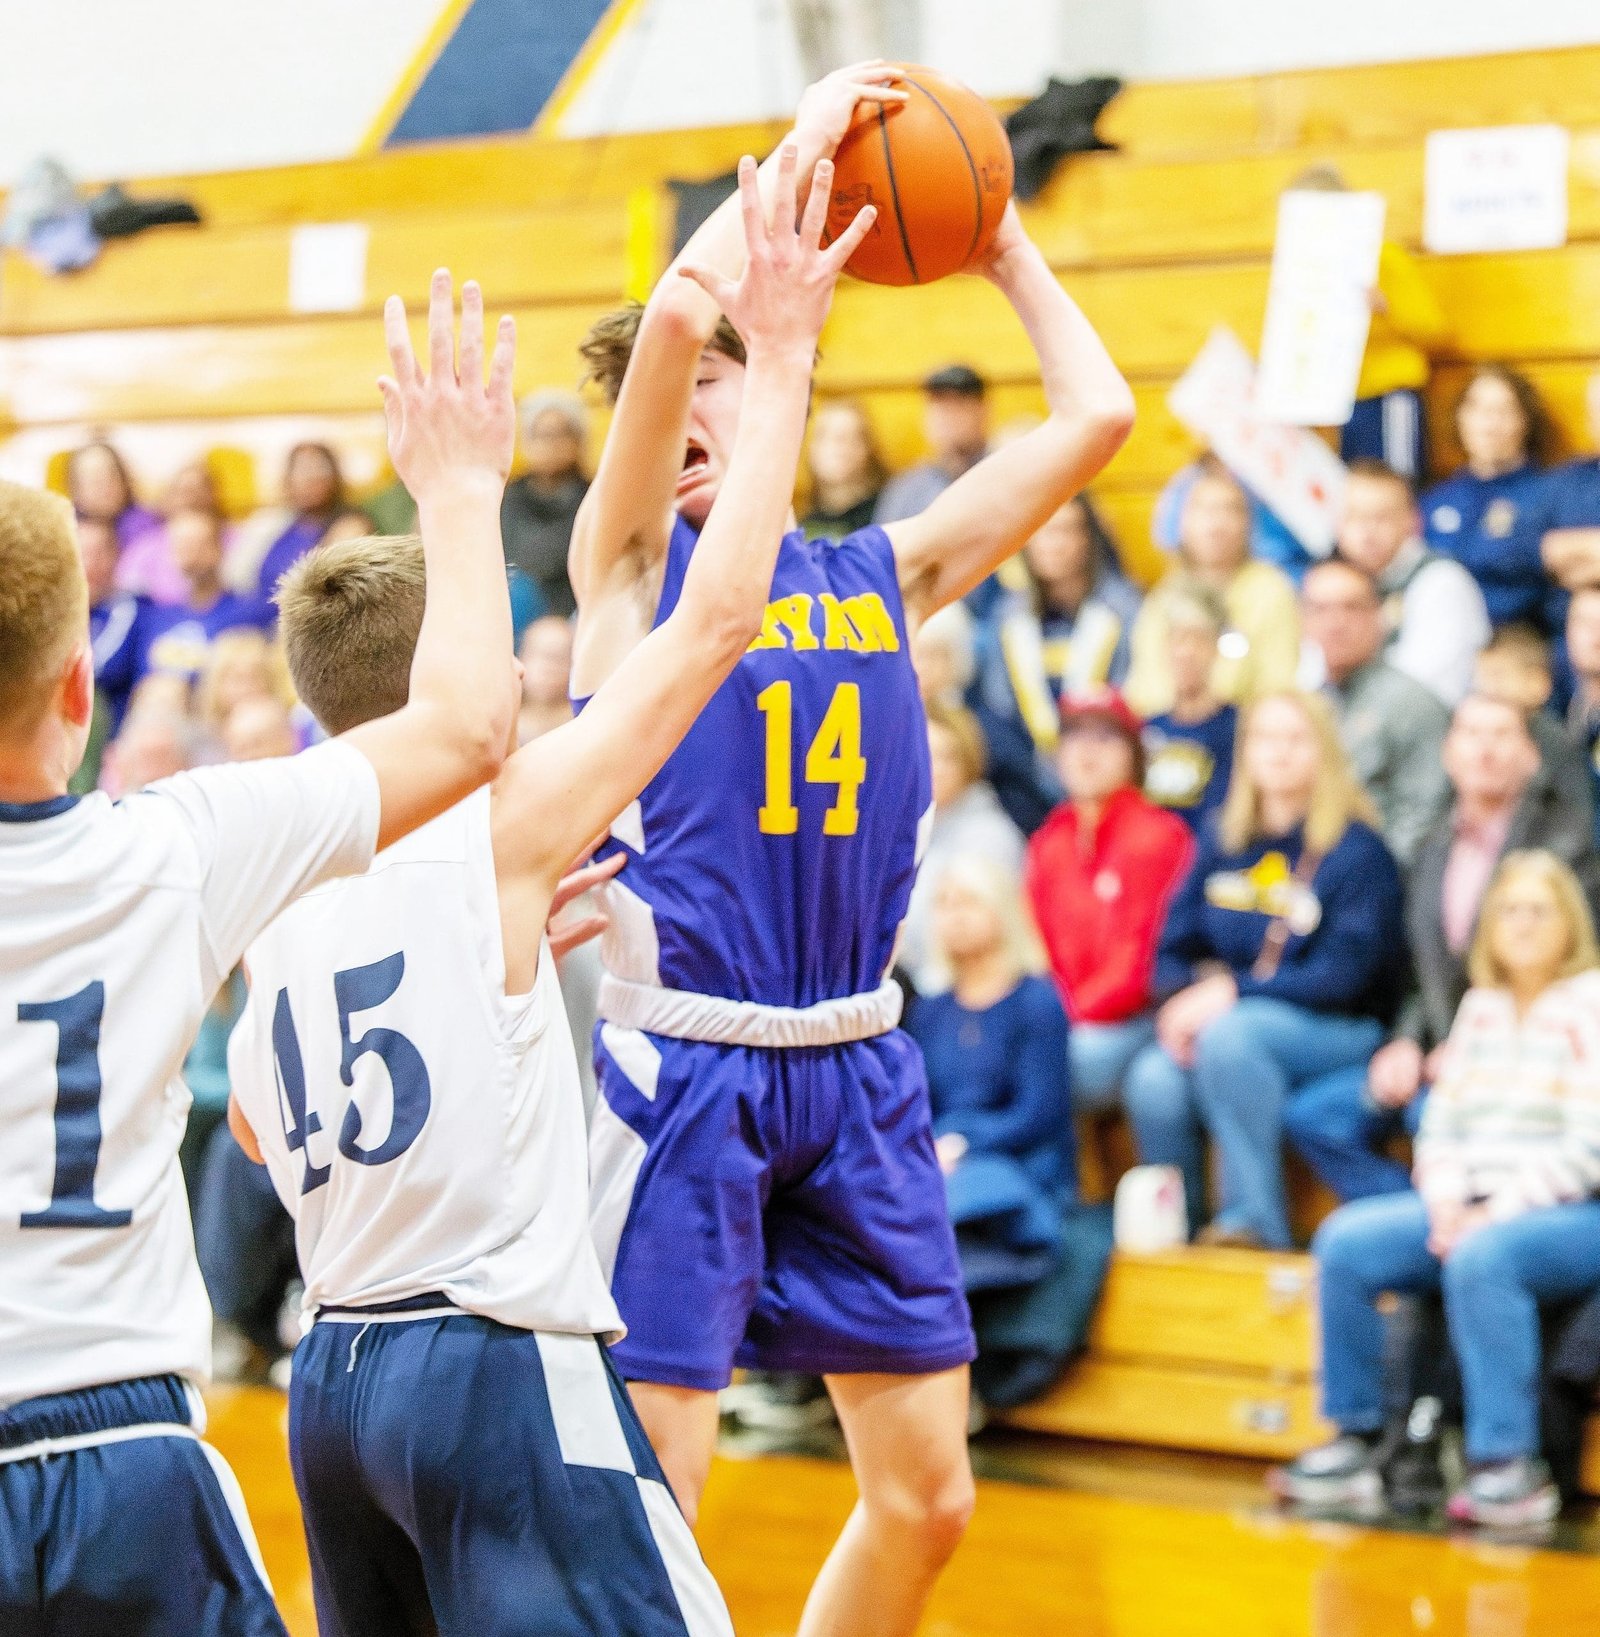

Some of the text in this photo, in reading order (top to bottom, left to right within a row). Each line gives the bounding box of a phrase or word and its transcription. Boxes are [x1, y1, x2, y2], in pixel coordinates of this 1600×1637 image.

[757, 680, 867, 836] 14
[17, 980, 134, 1230] 1
[273, 950, 432, 1197] 45
